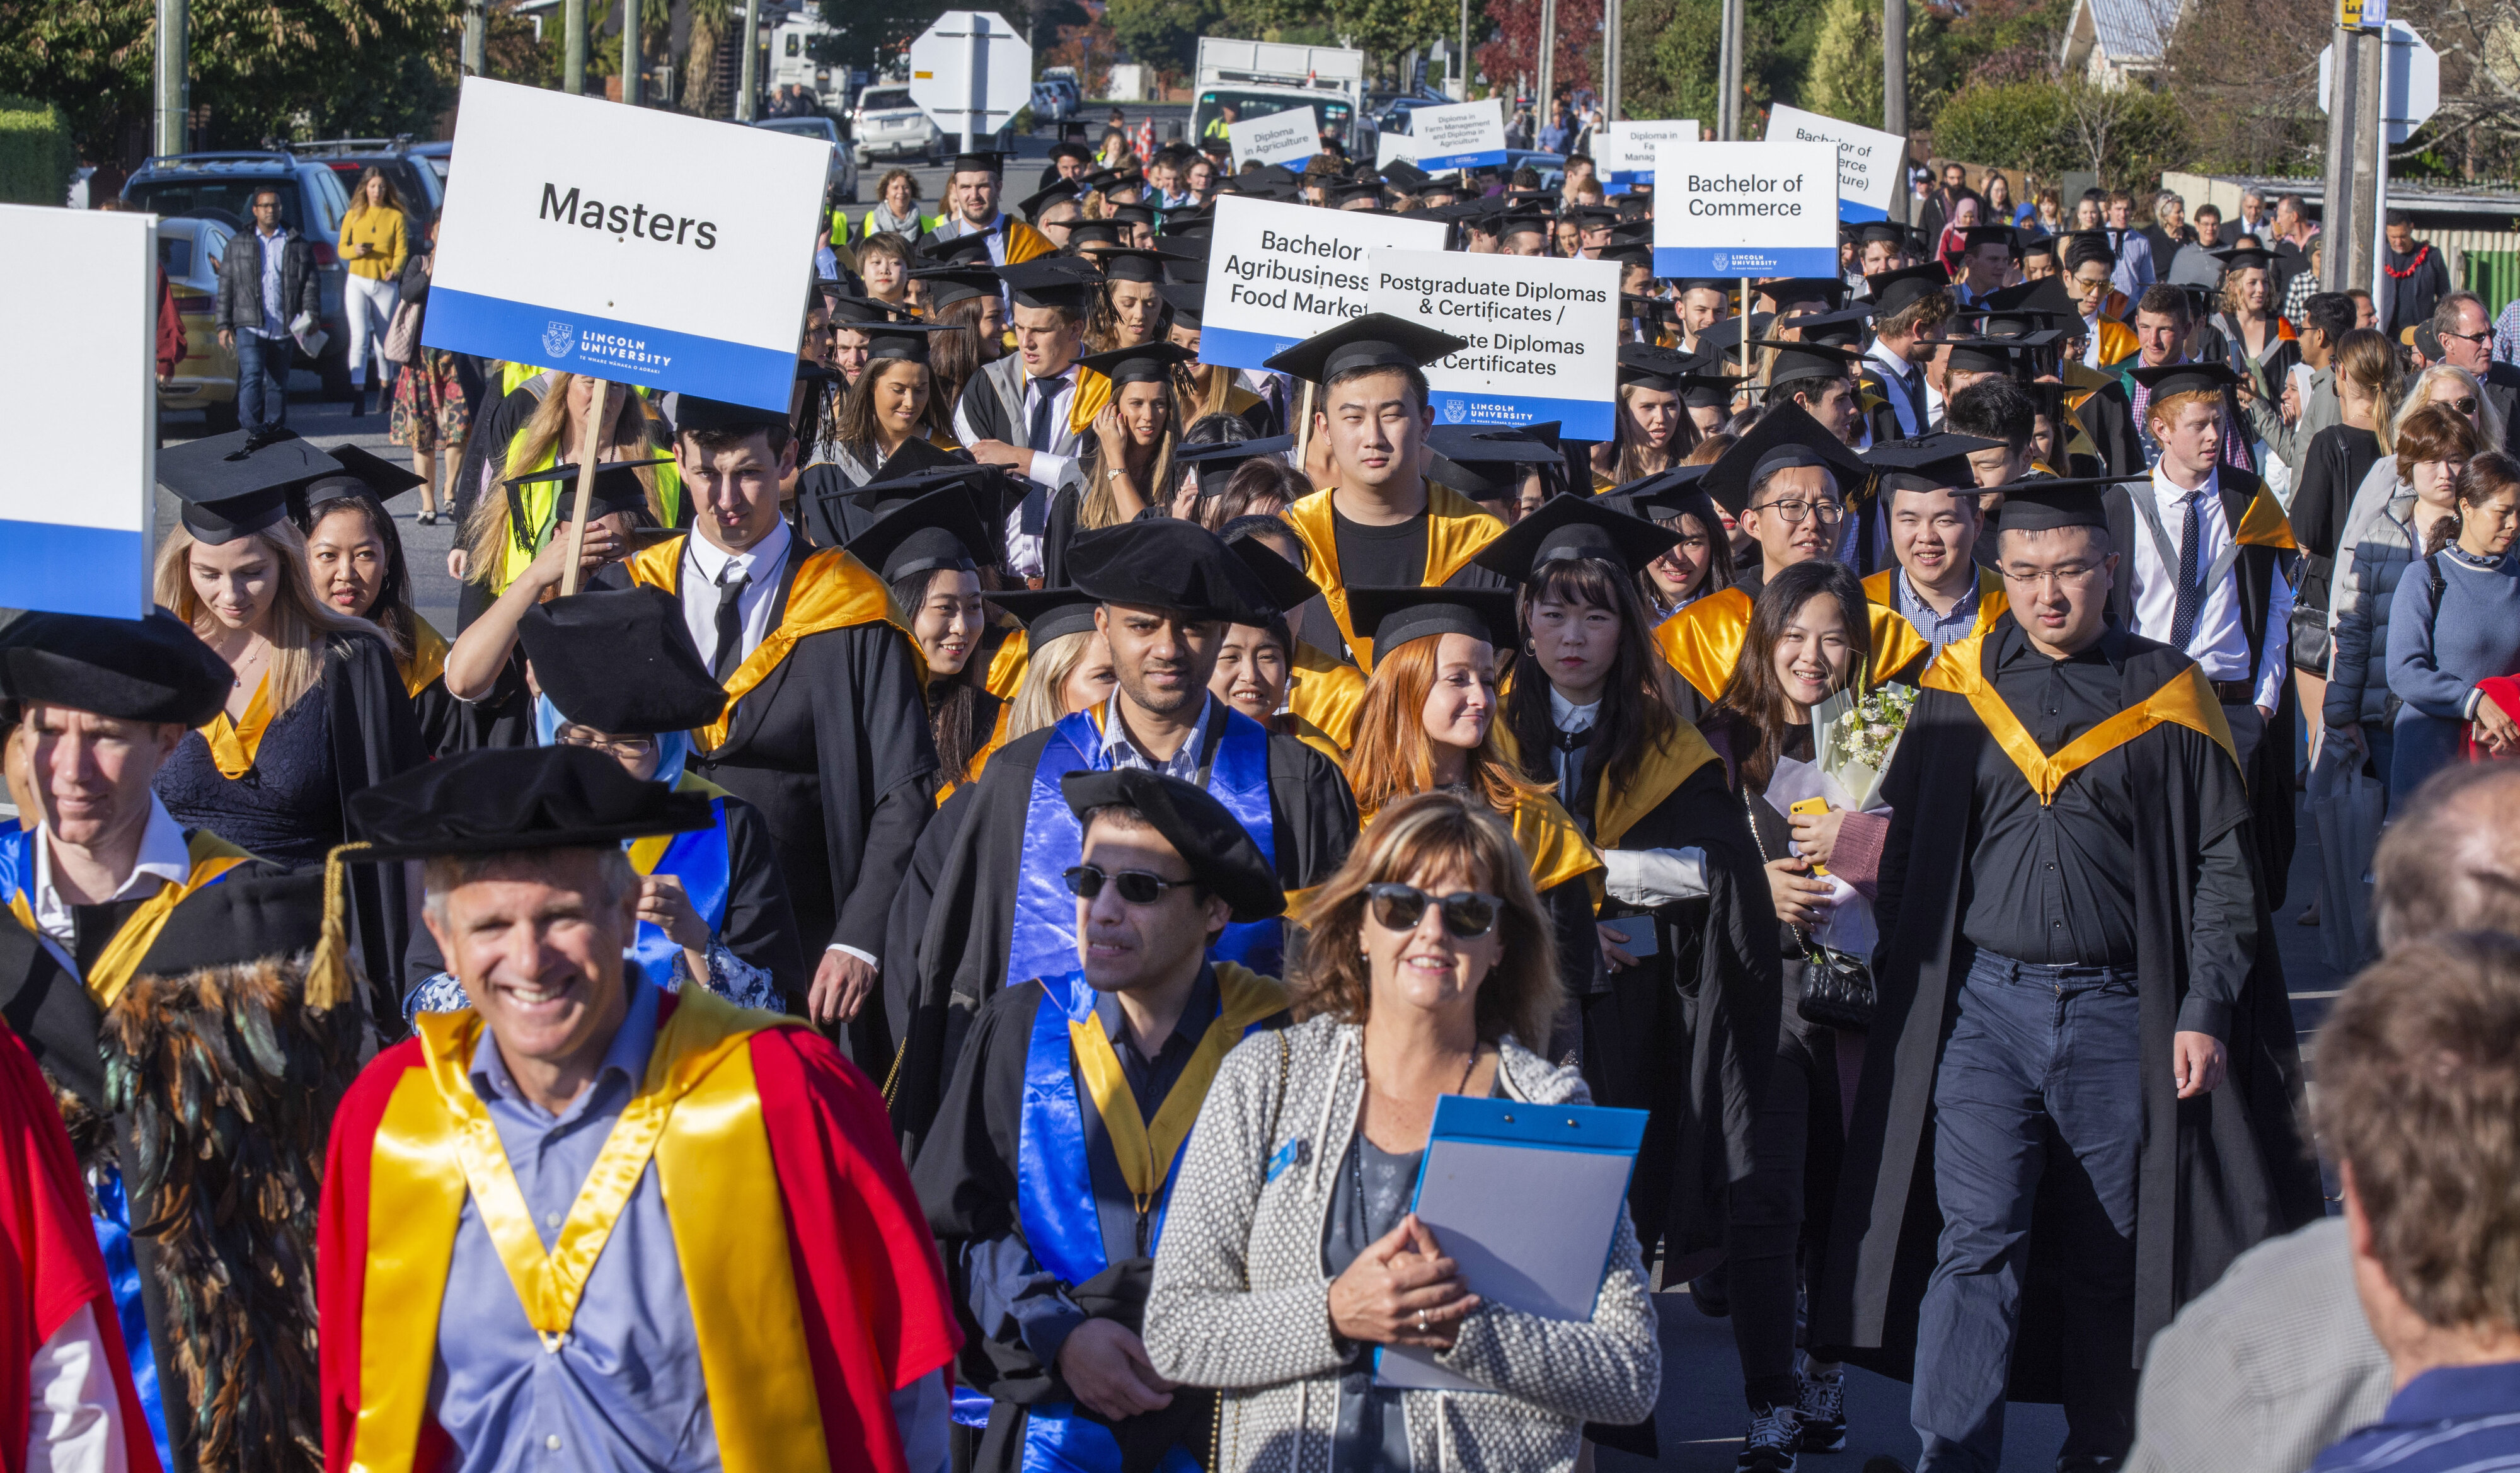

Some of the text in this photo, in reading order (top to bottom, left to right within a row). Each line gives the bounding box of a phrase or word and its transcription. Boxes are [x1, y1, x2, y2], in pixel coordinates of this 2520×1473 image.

[1439, 115, 1467, 124] Diploma
[1445, 119, 1490, 130] Management
[1255, 128, 1294, 142] Diploma
[1441, 137, 1479, 147] Agriculture
[1447, 130, 1476, 138] Diploma
[1631, 132, 1667, 141] Diploma
[1796, 128, 1872, 157] Bachor of
[1245, 136, 1309, 156] in Agriculture
[1625, 153, 1655, 162] Manag
[1839, 158, 1867, 173] erce
[1689, 174, 1803, 192] Bachelor of
[539, 182, 717, 250] Masters
[1689, 199, 1801, 216] Commerce
[1262, 230, 1362, 261] Bachelor
[1224, 255, 1369, 291] Agribusiness
[1380, 273, 1606, 303] Postgraduate Diplomas
[1231, 284, 1368, 318] Food Market
[1419, 298, 1565, 325] & Certificates /
[582, 330, 645, 350] LINCOLN
[1494, 333, 1585, 355] Diplomas
[581, 342, 671, 367] UNIVERSITY
[609, 361, 631, 369] WĀNAKA
[1443, 353, 1556, 375] Certificates
[1471, 403, 1514, 412] LINCOLN
[1471, 410, 1533, 420] UNIVERSITY
